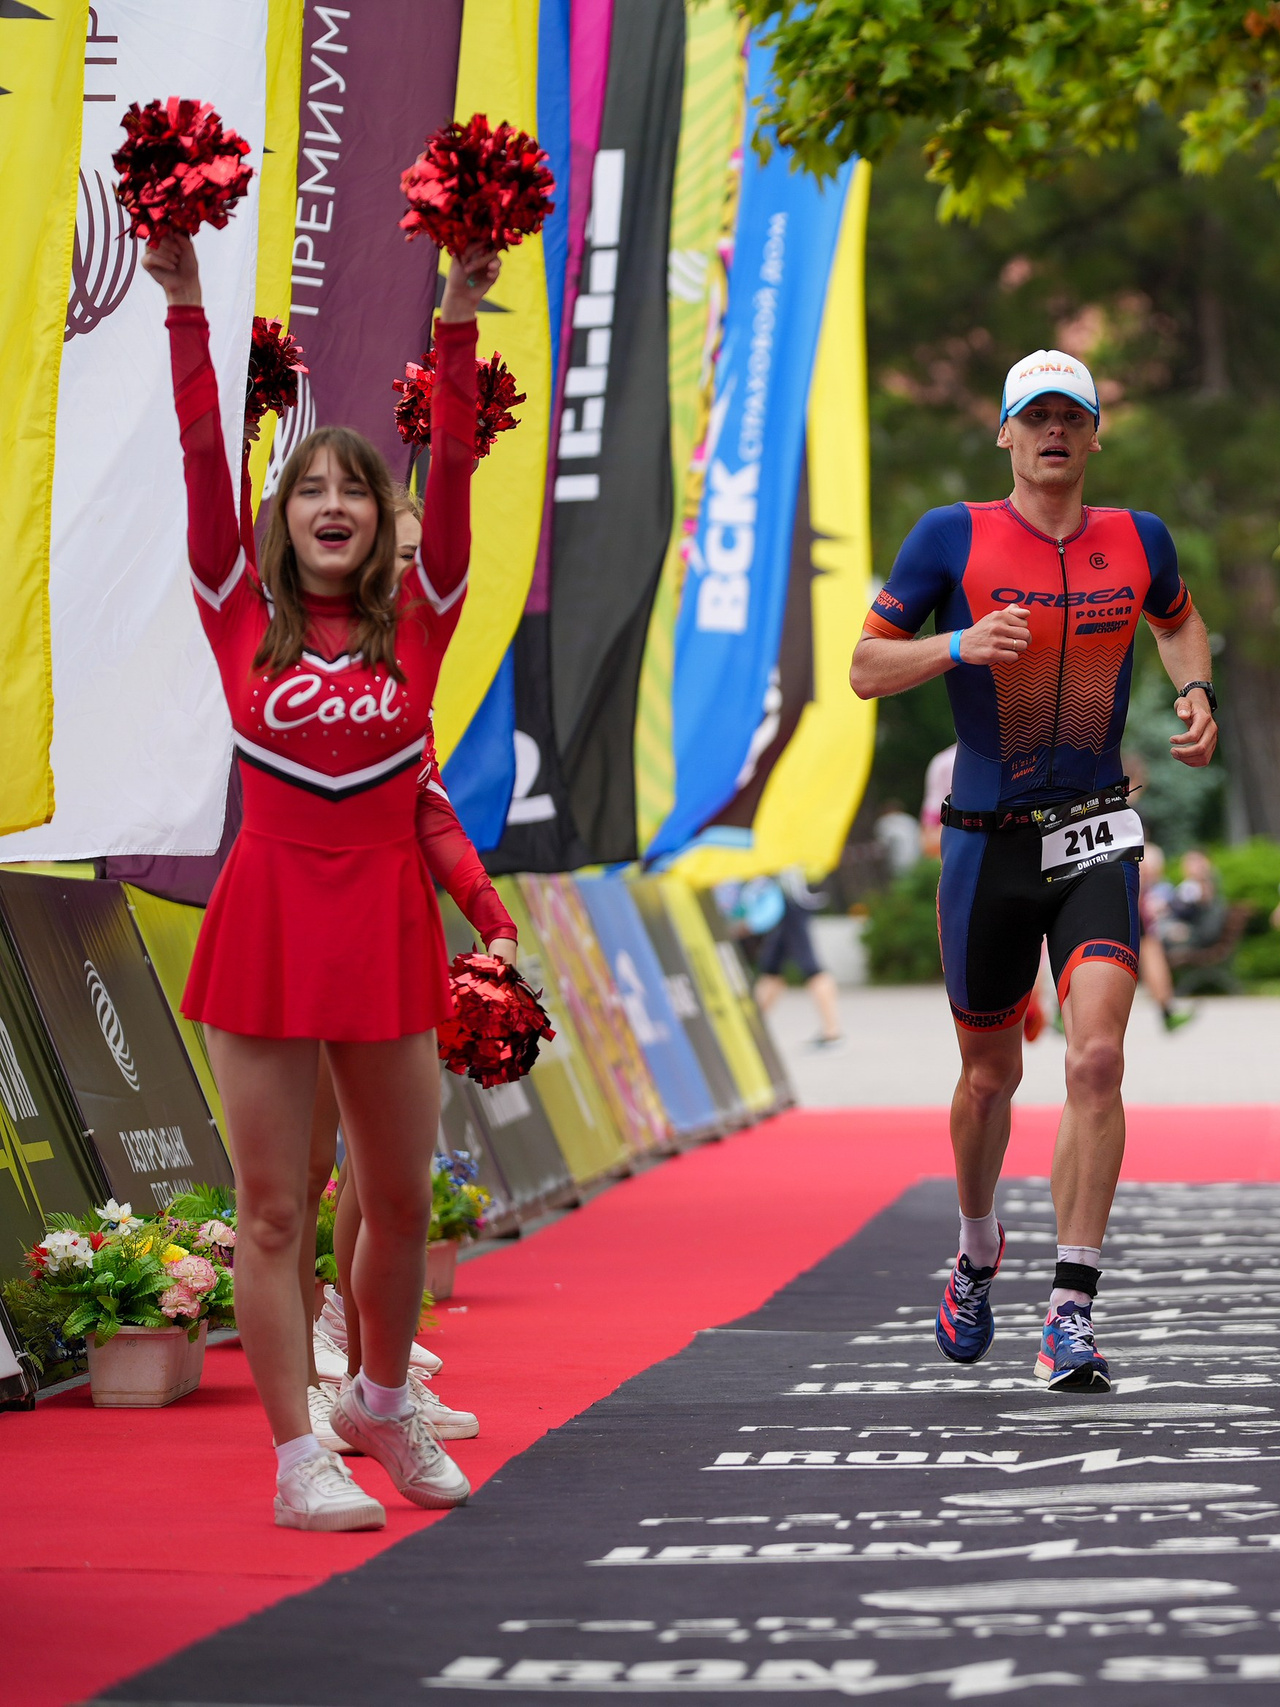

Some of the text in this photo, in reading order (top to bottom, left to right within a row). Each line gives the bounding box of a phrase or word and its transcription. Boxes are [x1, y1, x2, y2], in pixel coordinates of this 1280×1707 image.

[290, 5, 350, 316] ПРЕМИУМ
[1019, 362, 1075, 379] KONA
[696, 460, 760, 634] ВСК
[991, 586, 1135, 608] ORBEA
[1075, 606, 1132, 619] РОССИЯ
[264, 674, 402, 730] Cool
[1086, 797, 1100, 808] STAR
[1064, 821, 1114, 857] 214
[1077, 853, 1108, 870] DMITRIY
[118, 1126, 194, 1173] ГАЗПРОМБАНК
[793, 1378, 1050, 1392] IRON
[713, 1451, 1022, 1466] IRON
[602, 1541, 962, 1560] IRON
[440, 1656, 877, 1682] IRON
